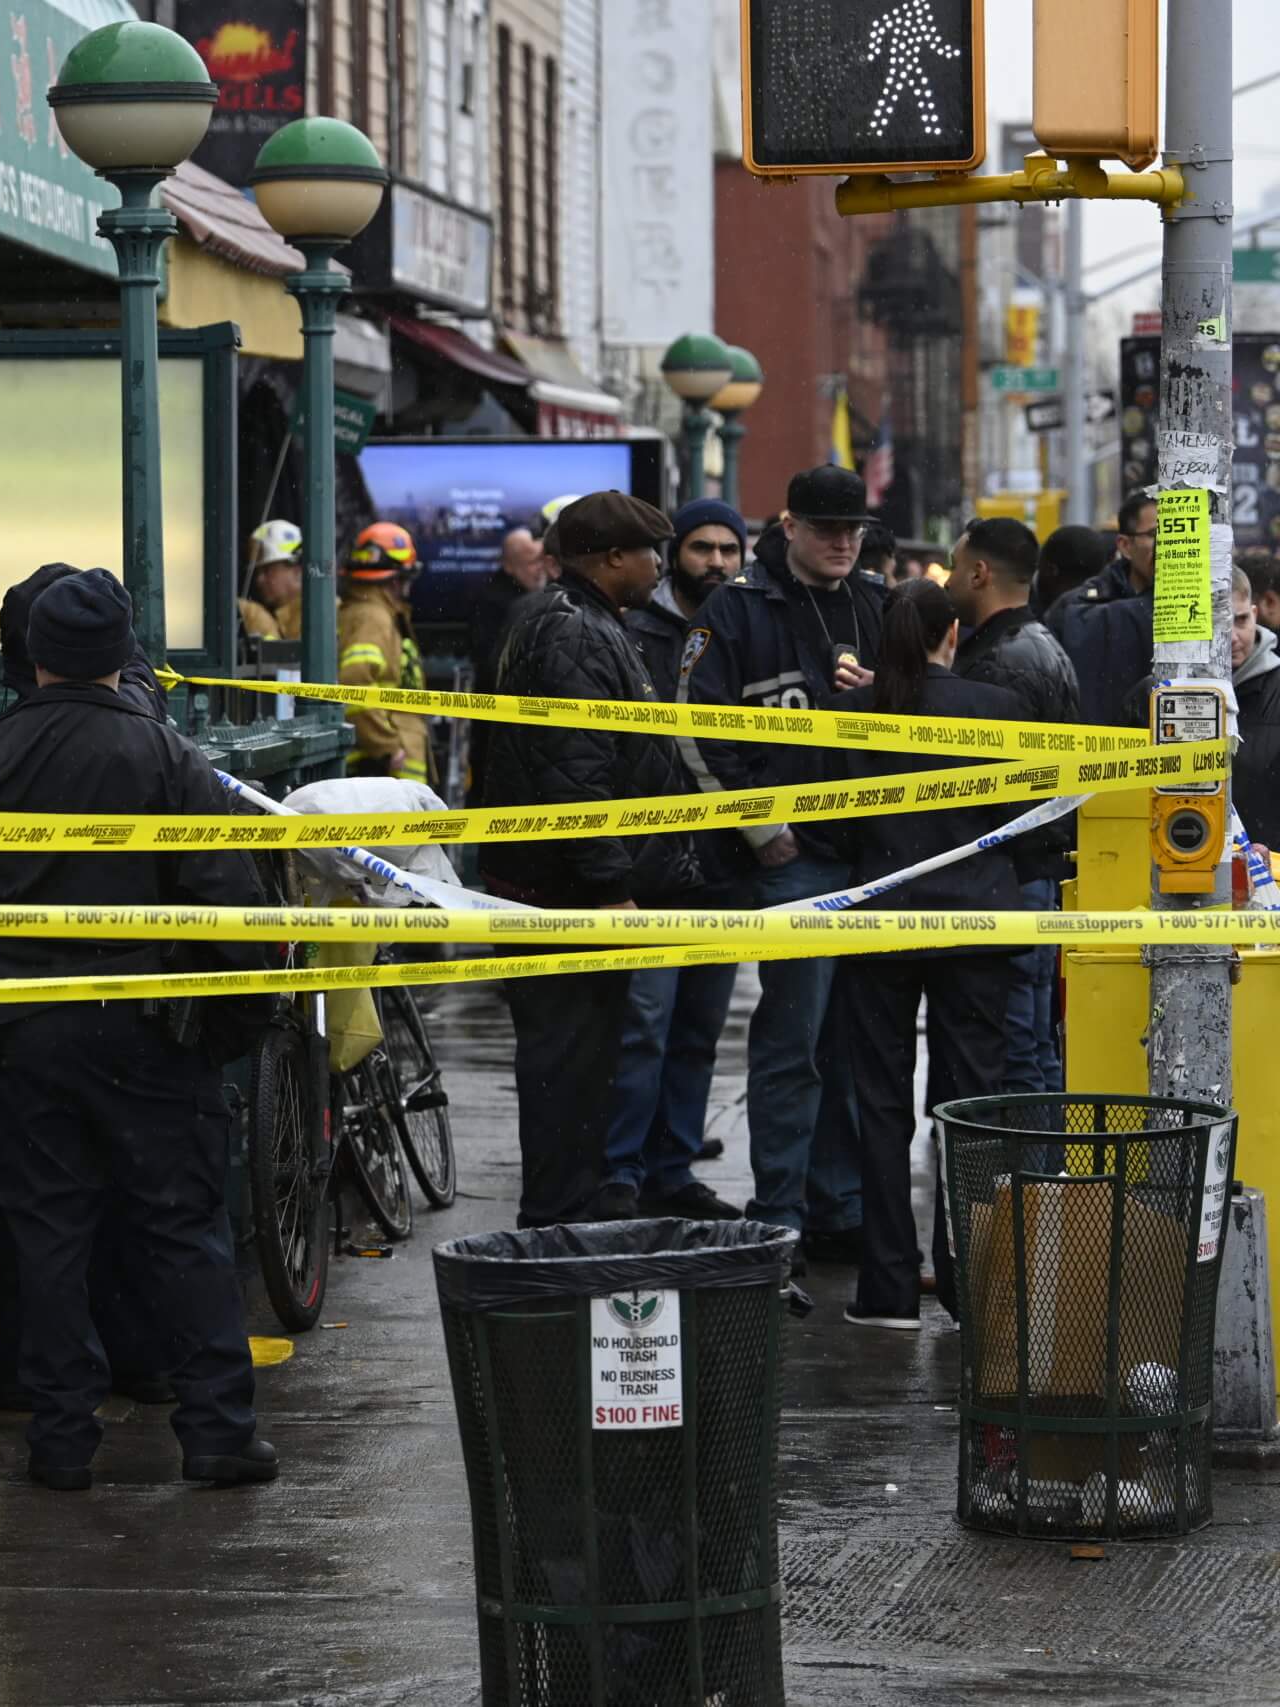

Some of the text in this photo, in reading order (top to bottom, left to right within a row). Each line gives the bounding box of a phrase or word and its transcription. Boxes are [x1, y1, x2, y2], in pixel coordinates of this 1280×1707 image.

[1163, 517, 1200, 533] SST
[1079, 755, 1182, 783] CRIME SCENE DO NOT CROSS
[1193, 750, 1214, 773] (8477)
[916, 776, 997, 802] 1-800-577-TIPS (8477)
[793, 786, 905, 813] CRIME SCENE DO NOT CROSS
[486, 813, 608, 834] CRIME SCENE DO NOT CROSS
[616, 807, 708, 829] 1-800-577-TIPS (8477)
[154, 827, 286, 842] CRIME SCENE DO NOT CROSS
[296, 825, 394, 842] 1-800-577-TIPS (8477)
[65, 912, 218, 927] 1-800-577-TIPS (8477)
[244, 915, 449, 928] CRIME SCENE DO NOT CROSS
[611, 917, 764, 930] 1-800-577-TIPS (8477)
[790, 916, 996, 930] CRIME SCENE DO NOT CROSS
[1159, 915, 1266, 928] 1-800-577-TIPS
[593, 1335, 678, 1349] NO HOUSEHOLD
[619, 1351, 657, 1362] TRASH
[601, 1369, 675, 1382] NO BUSINESS
[619, 1384, 658, 1395] TRASH
[595, 1404, 680, 1423] $100 FINE
